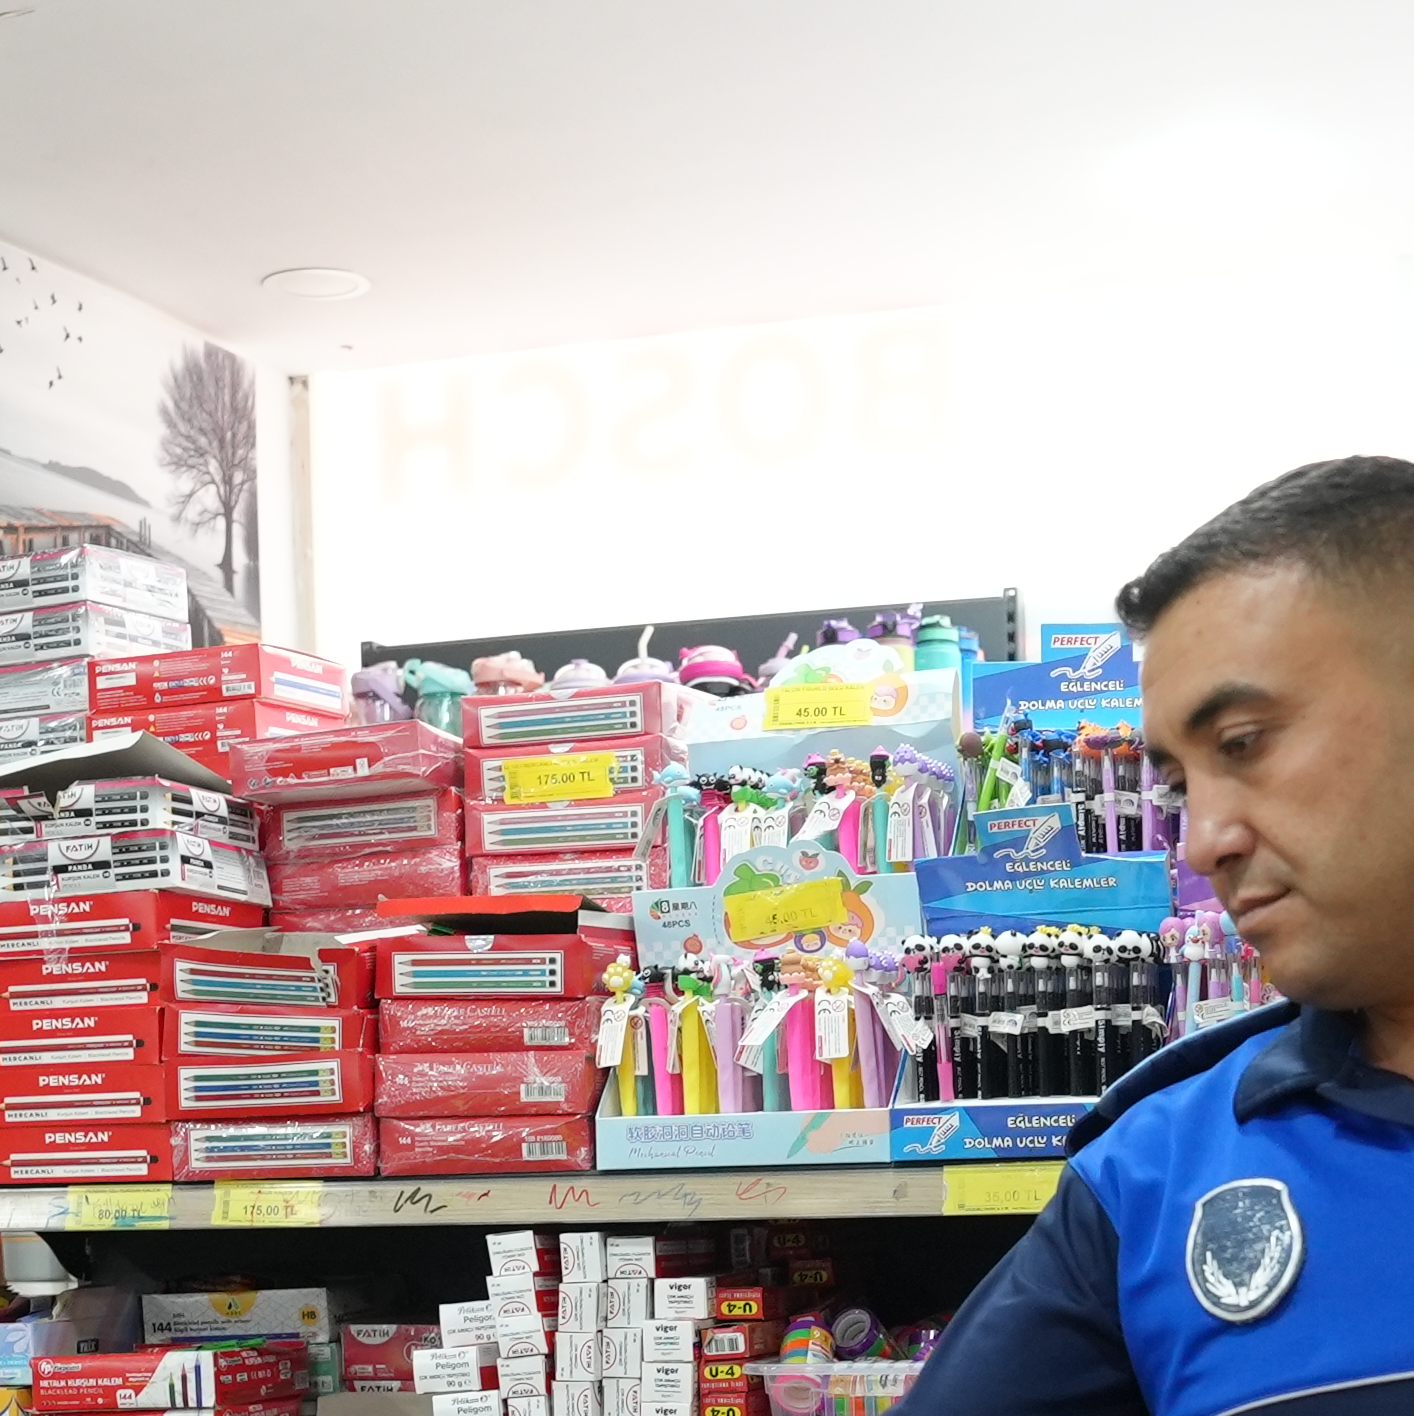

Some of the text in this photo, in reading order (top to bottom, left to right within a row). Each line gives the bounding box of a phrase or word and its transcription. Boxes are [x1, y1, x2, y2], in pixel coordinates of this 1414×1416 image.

[1052, 635, 1101, 646] PERFECT
[1018, 699, 1065, 711] DOLMA
[795, 706, 846, 718] 45.00 TL
[536, 771, 596, 785] 175.00 TL
[988, 819, 1038, 832] PERFECT
[67, 863, 93, 872] PANDA
[965, 879, 1013, 891] DOLMA
[1049, 875, 1118, 889] KALEMLER
[800, 909, 818, 920] TL
[42, 962, 107, 976] PENSAN
[32, 1017, 96, 1031] PENSAN
[2, 1054, 42, 1063] MERCANLI
[38, 1073, 103, 1087] PENSAN
[7, 1111, 48, 1119] MERCANLI
[903, 1115, 944, 1127] PERFECT
[44, 1131, 109, 1144] PENSAN
[626, 1121, 755, 1143] 软胶洞洞自动铅笔
[963, 1136, 1013, 1149] DOLMA
[13, 1168, 54, 1176] MERCANLI
[1025, 1188, 1043, 1203] TL
[97, 1208, 127, 1221] 80,00
[242, 1204, 298, 1218] 175,00 TL
[301, 1310, 317, 1320] HB
[152, 1322, 173, 1334] 144
[435, 1361, 469, 1371] Peligom
[655, 1365, 679, 1377] vigor
[709, 1365, 736, 1377] U-4
[97, 1377, 123, 1386] KALEM
[446, 1380, 455, 1388] 90
[40, 1387, 104, 1396] BLACKLEAD PENCIL
[118, 1392, 133, 1401] 144
[457, 1405, 493, 1415] Peligom
